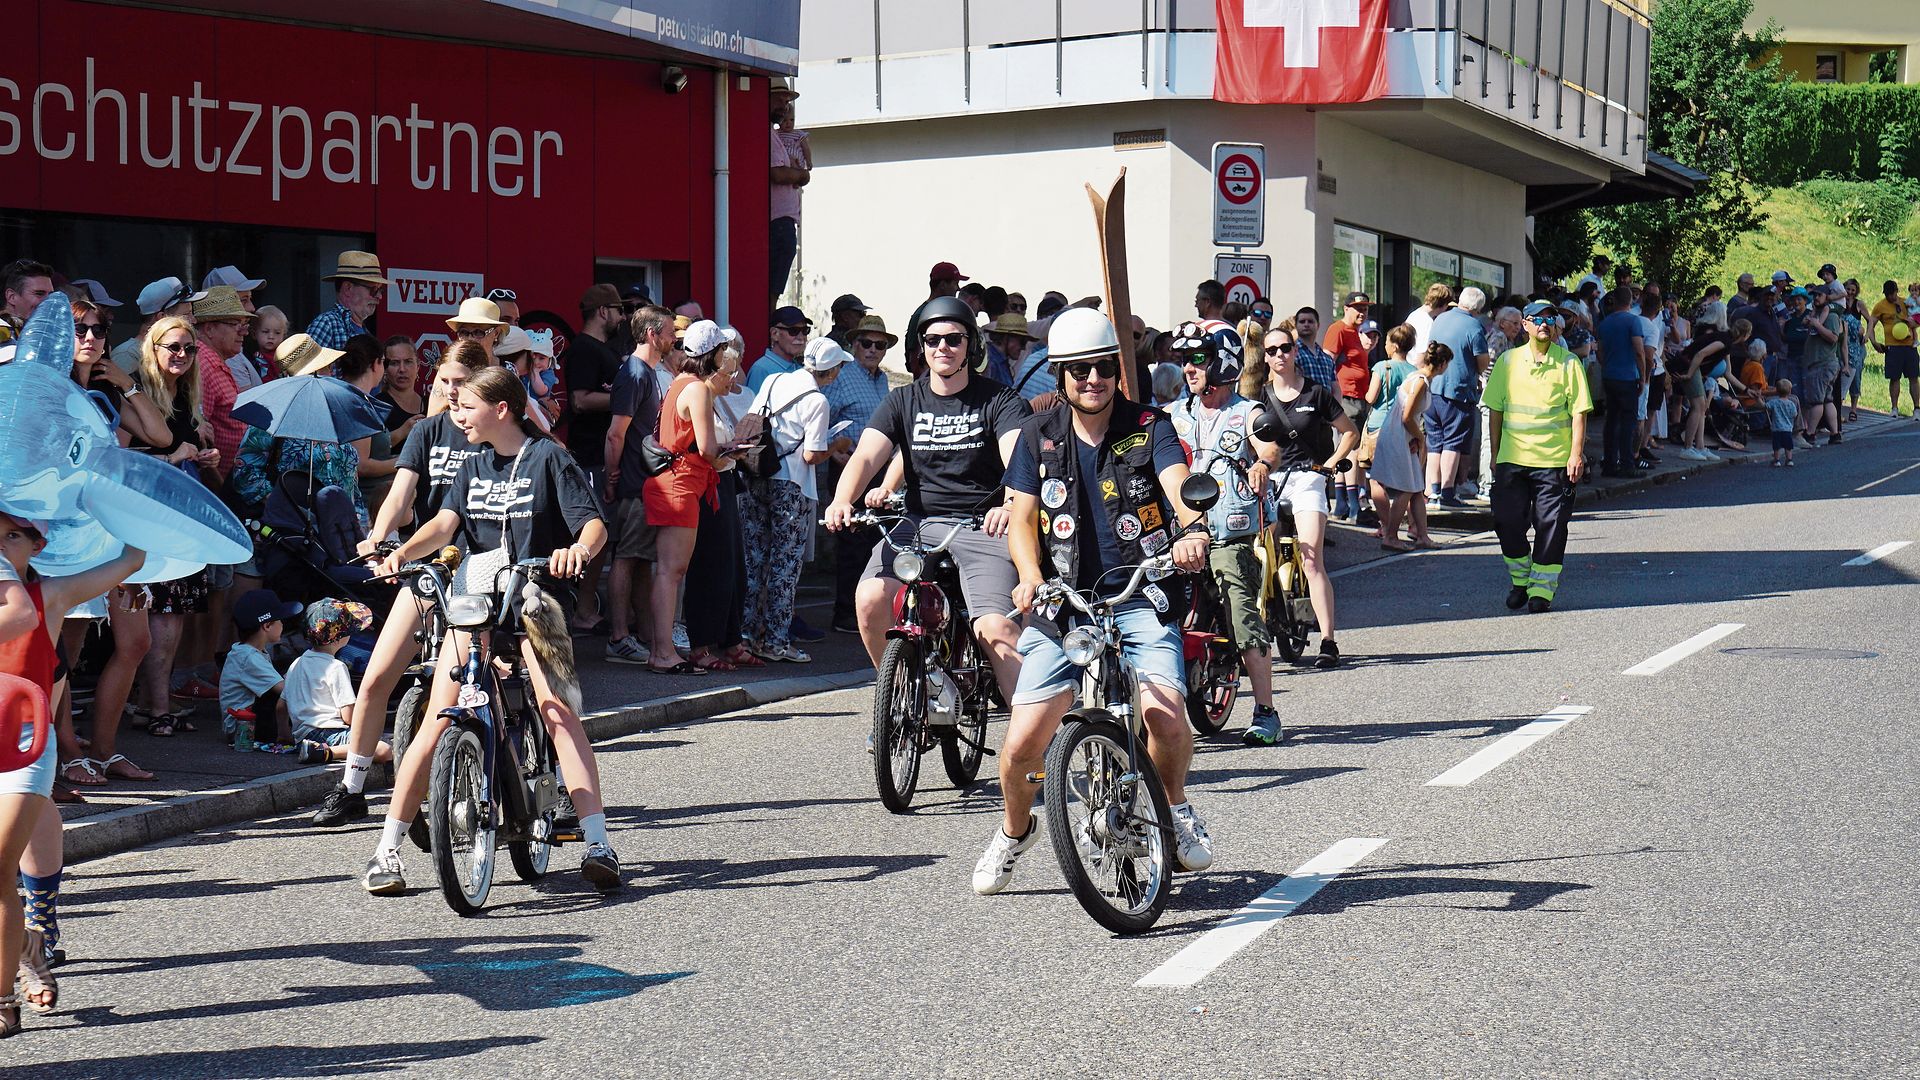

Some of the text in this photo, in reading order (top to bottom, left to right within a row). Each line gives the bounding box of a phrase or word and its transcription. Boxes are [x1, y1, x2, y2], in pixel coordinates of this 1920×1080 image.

[658, 15, 743, 53] petrolstation.ch
[1231, 263, 1254, 273] ZONE
[395, 278, 476, 306] VELUX
[1234, 292, 1250, 305] 30
[934, 412, 979, 425] stroke
[932, 423, 970, 437] parts
